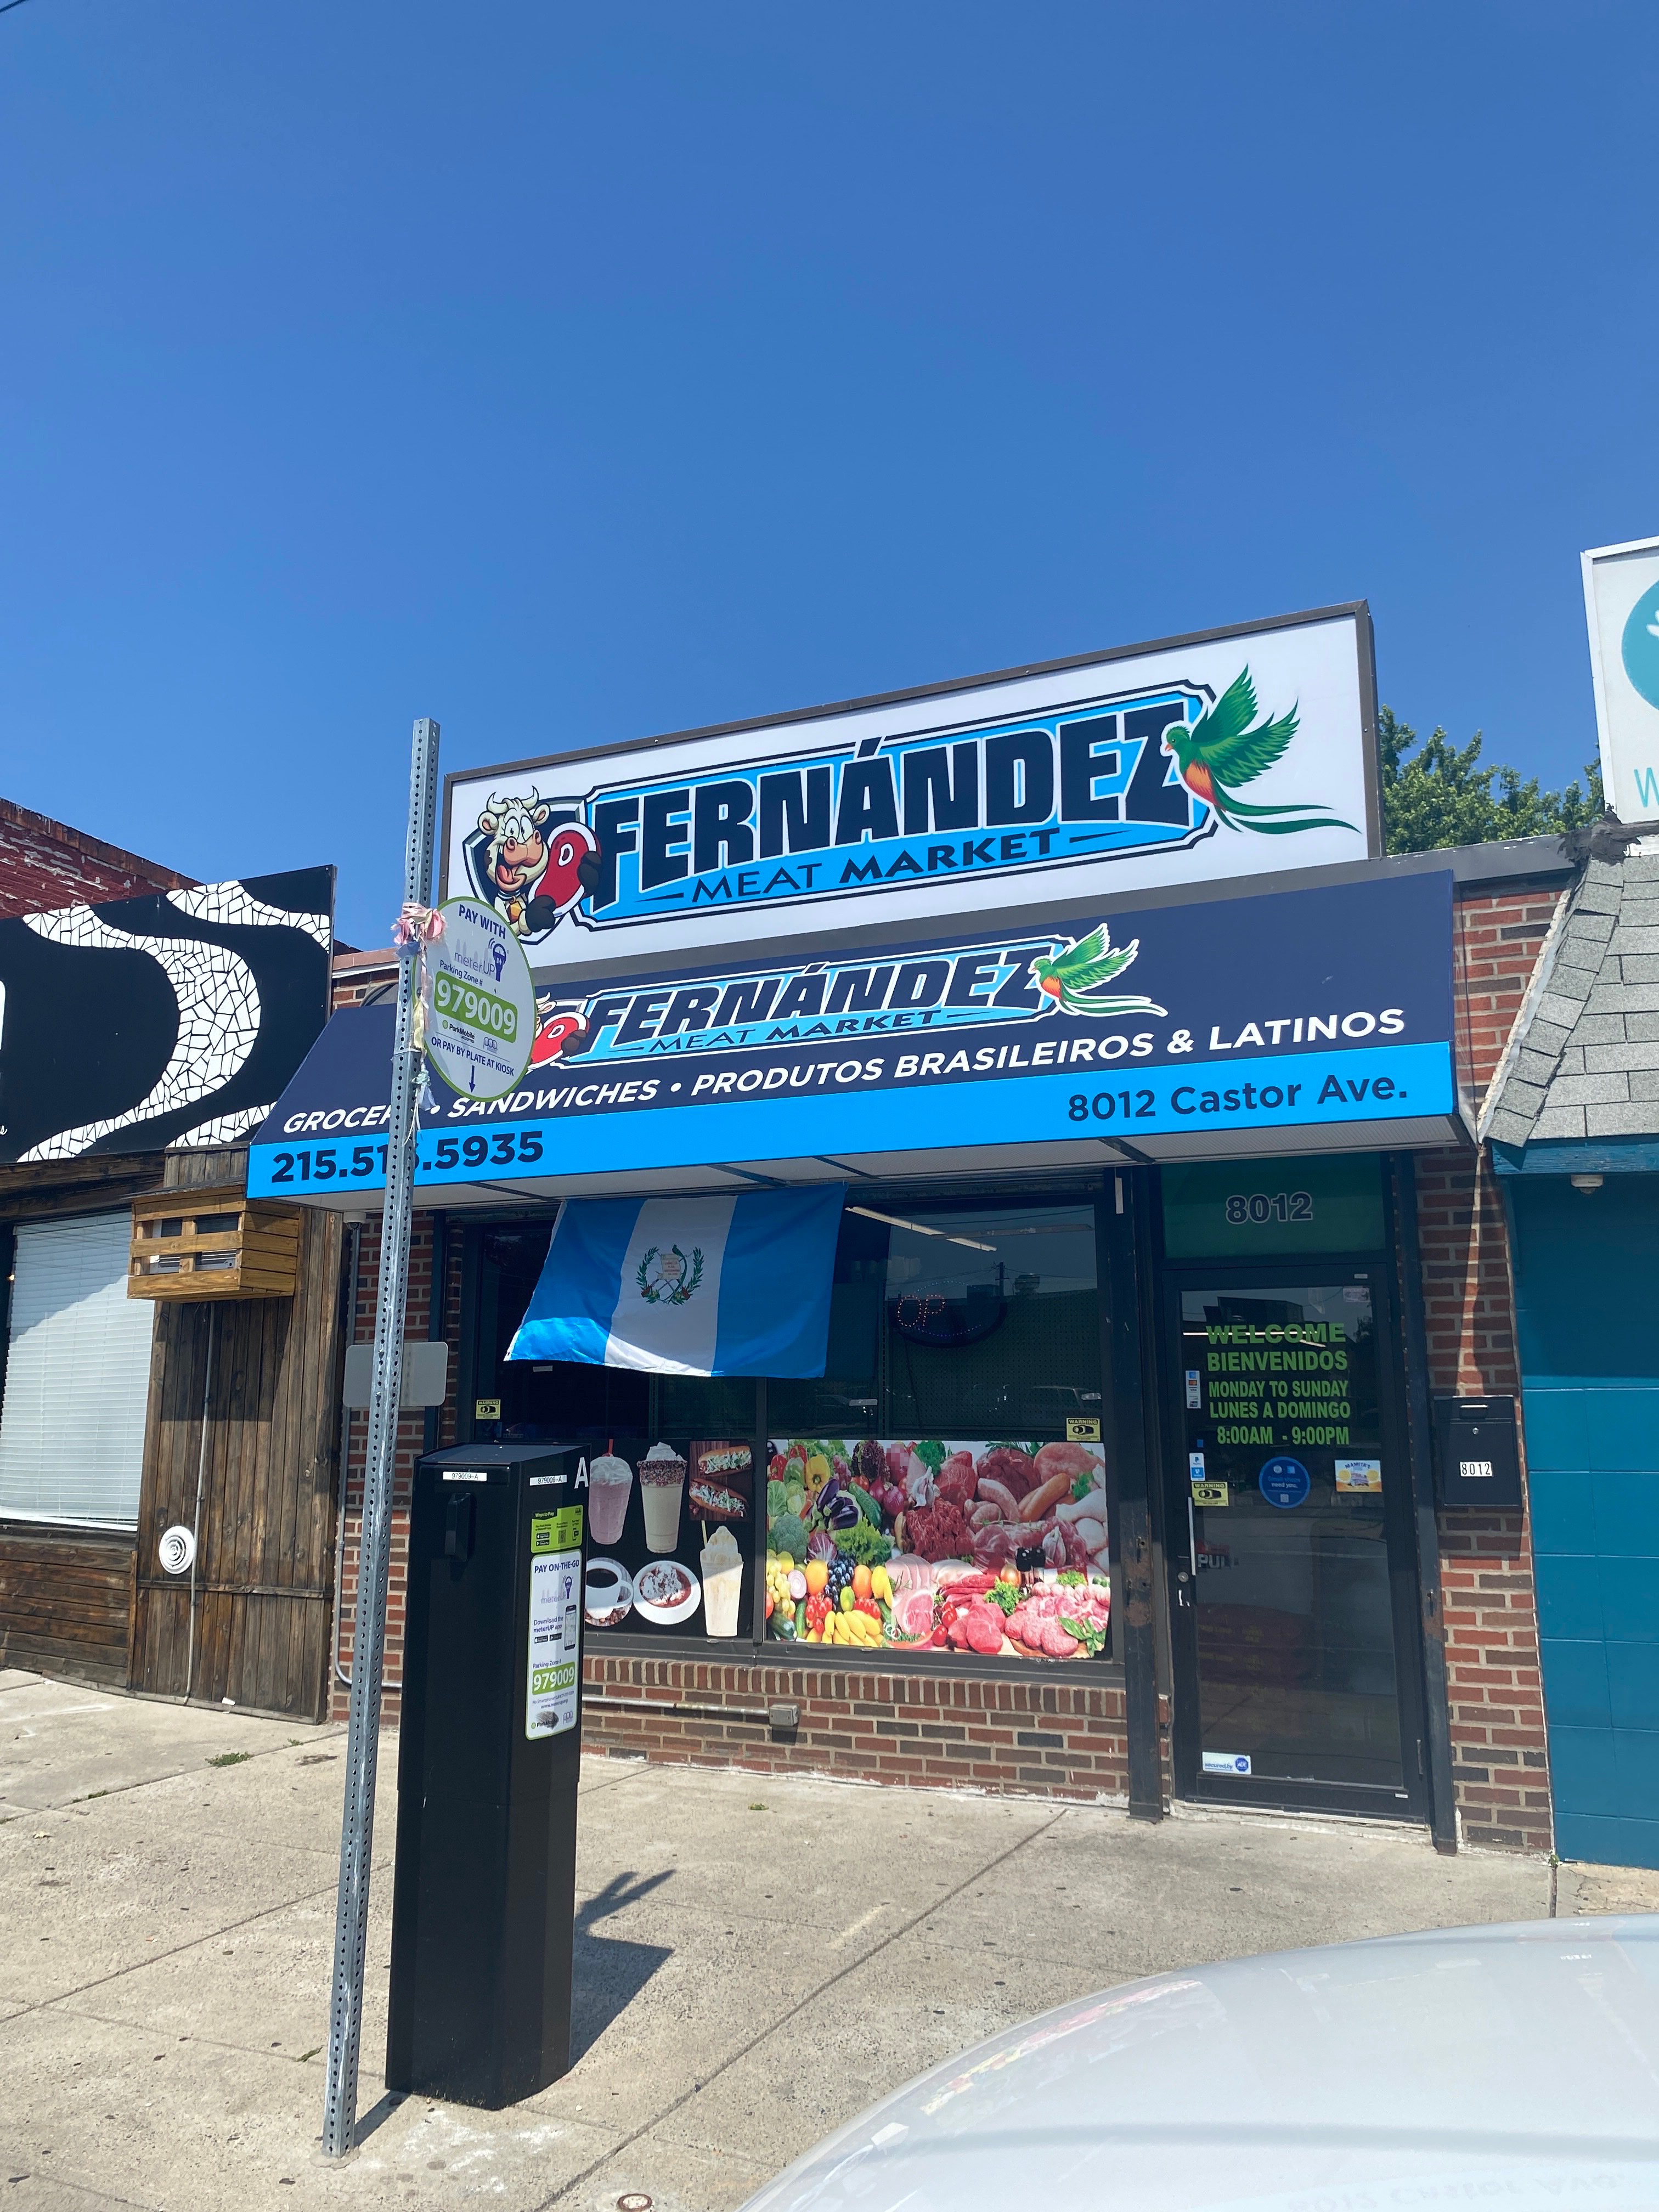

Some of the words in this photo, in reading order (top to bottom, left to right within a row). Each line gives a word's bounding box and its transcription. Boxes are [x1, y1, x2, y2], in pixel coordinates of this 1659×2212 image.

[591, 701, 1189, 915] FERNÁNDEZ
[692, 862, 823, 903] MEAT
[839, 828, 1060, 884] MARKET
[459, 904, 478, 924] PAY
[480, 915, 506, 939] WITH
[439, 960, 462, 979] Parking
[463, 970, 478, 984] Zone
[454, 952, 495, 975] meterUP
[438, 979, 516, 1034] 979009
[573, 945, 1052, 1054] FERNÁNDEZ
[449, 1023, 475, 1039] ParkMobile
[648, 1030, 757, 1052] MEAT
[765, 1009, 941, 1040] MARKET
[431, 1036, 441, 1048] OR
[443, 1041, 455, 1053] PAY
[456, 1046, 466, 1057] BY
[466, 1050, 486, 1065] PLATE
[487, 1058, 495, 1068] AT
[495, 1062, 515, 1076] KIOSK
[284, 1104, 391, 1133] GROCE
[447, 1079, 660, 1118] SANDWICHES
[691, 1058, 885, 1096] PRODUTOS
[894, 1033, 1154, 1078] BRASILEIROS
[1167, 1030, 1194, 1054] &
[1209, 1008, 1406, 1051] LATINOS
[272, 1131, 544, 1183] 215.51.5935
[1068, 1089, 1156, 1122] 8012
[1171, 1082, 1301, 1115] Castor
[1317, 1074, 1407, 1104] Ave.
[1226, 1191, 1313, 1224] 8012
[1206, 1323, 1346, 1344] WELCOME
[1207, 1350, 1348, 1371] BIENVENIDOS
[1209, 1381, 1265, 1397] MONDAY
[1269, 1381, 1288, 1397] TO
[1292, 1380, 1348, 1397] SUNDAY
[1210, 1402, 1258, 1418] LUNES
[1263, 1402, 1273, 1418] A
[1278, 1401, 1351, 1418] DOMINGO
[1217, 1426, 1273, 1444] 8:00AM
[1291, 1426, 1350, 1445] 9:00PM
[574, 1457, 589, 1489] A
[1462, 1463, 1491, 1475] 8012
[534, 1565, 548, 1573] PAY
[549, 1559, 579, 1572] ON-THE-GO
[534, 1617, 557, 1626] Download
[533, 1667, 574, 1691] 979009
